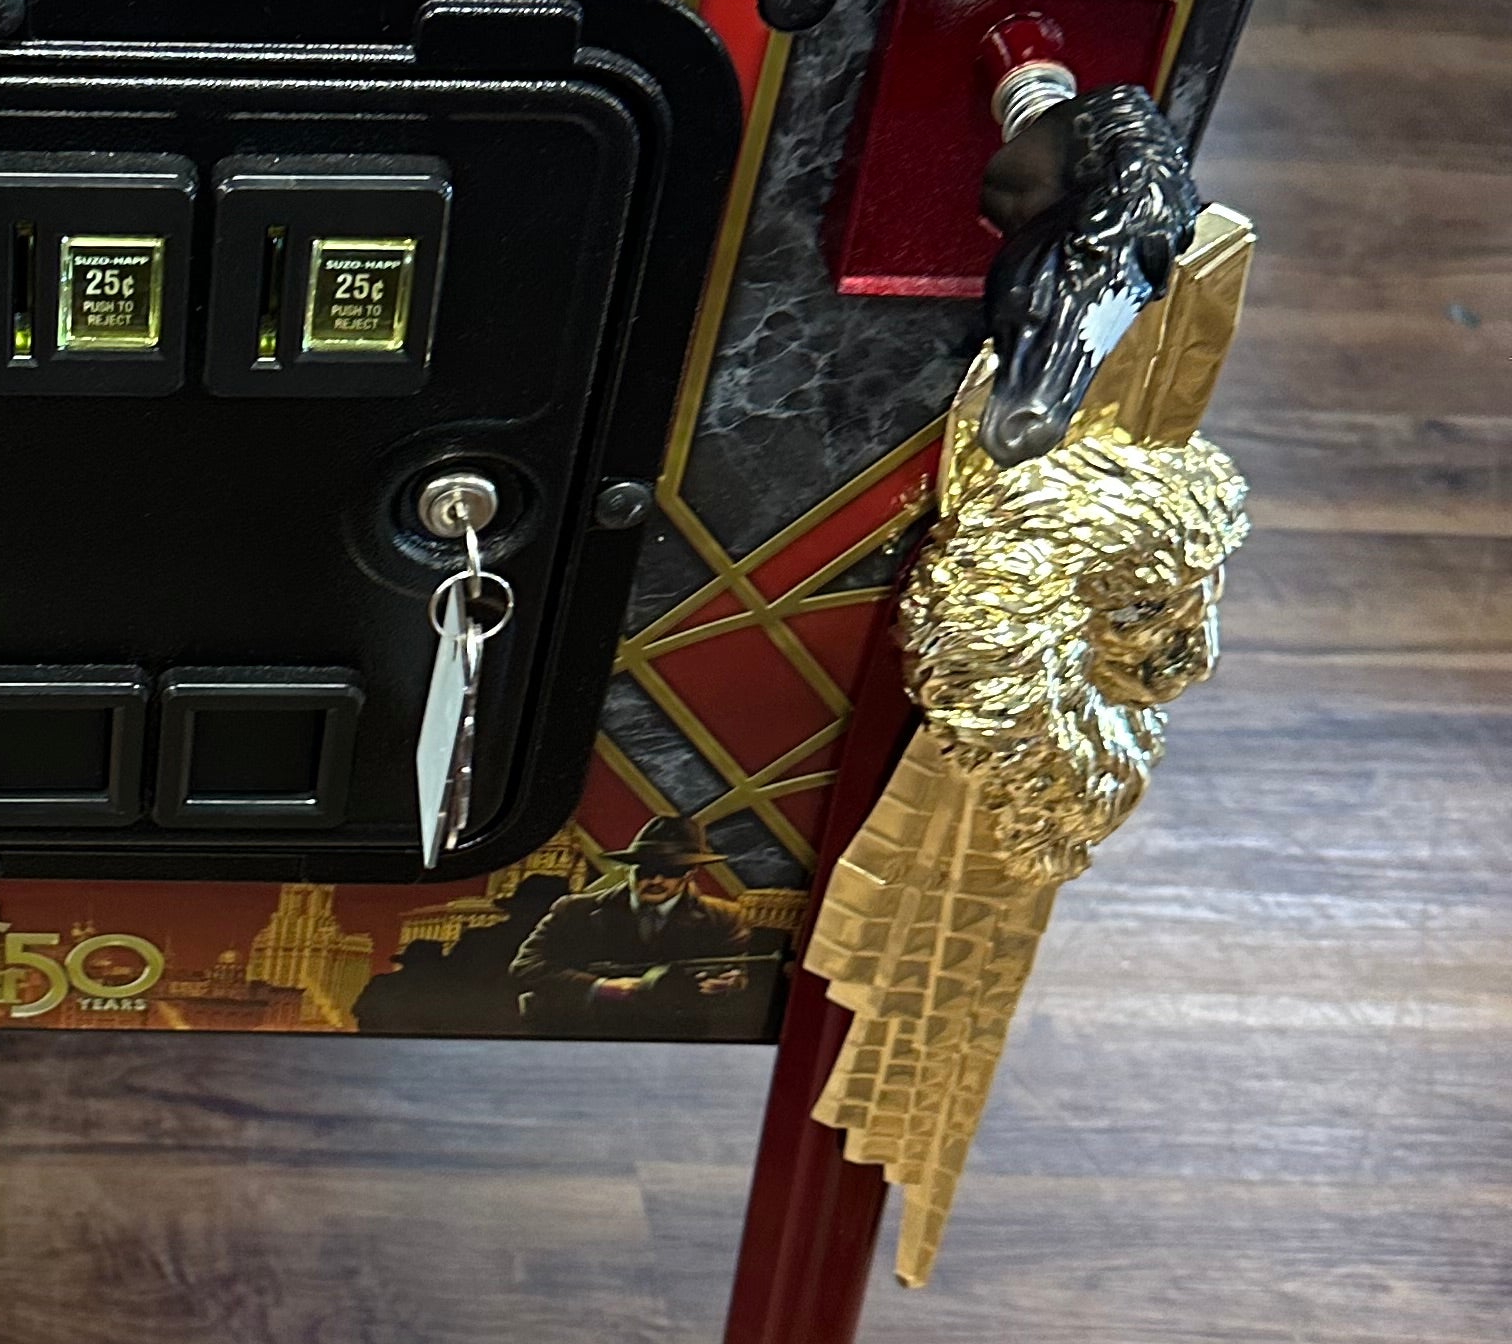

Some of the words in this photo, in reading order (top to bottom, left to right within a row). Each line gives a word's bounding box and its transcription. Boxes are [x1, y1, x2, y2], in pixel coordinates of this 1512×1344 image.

[74, 256, 149, 266] SUZO-HAPP
[325, 260, 401, 270] SUZO-HAPP
[85, 268, 135, 299] 25¢
[334, 272, 384, 303] 25¢
[83, 300, 115, 313] PUSH
[117, 300, 134, 313] TO
[331, 304, 364, 317] PUSH
[365, 304, 382, 317] TO
[87, 314, 133, 327] REJECT
[334, 317, 380, 330] REJECT
[4, 933, 165, 1018] 50
[76, 998, 147, 1011] YEARS
